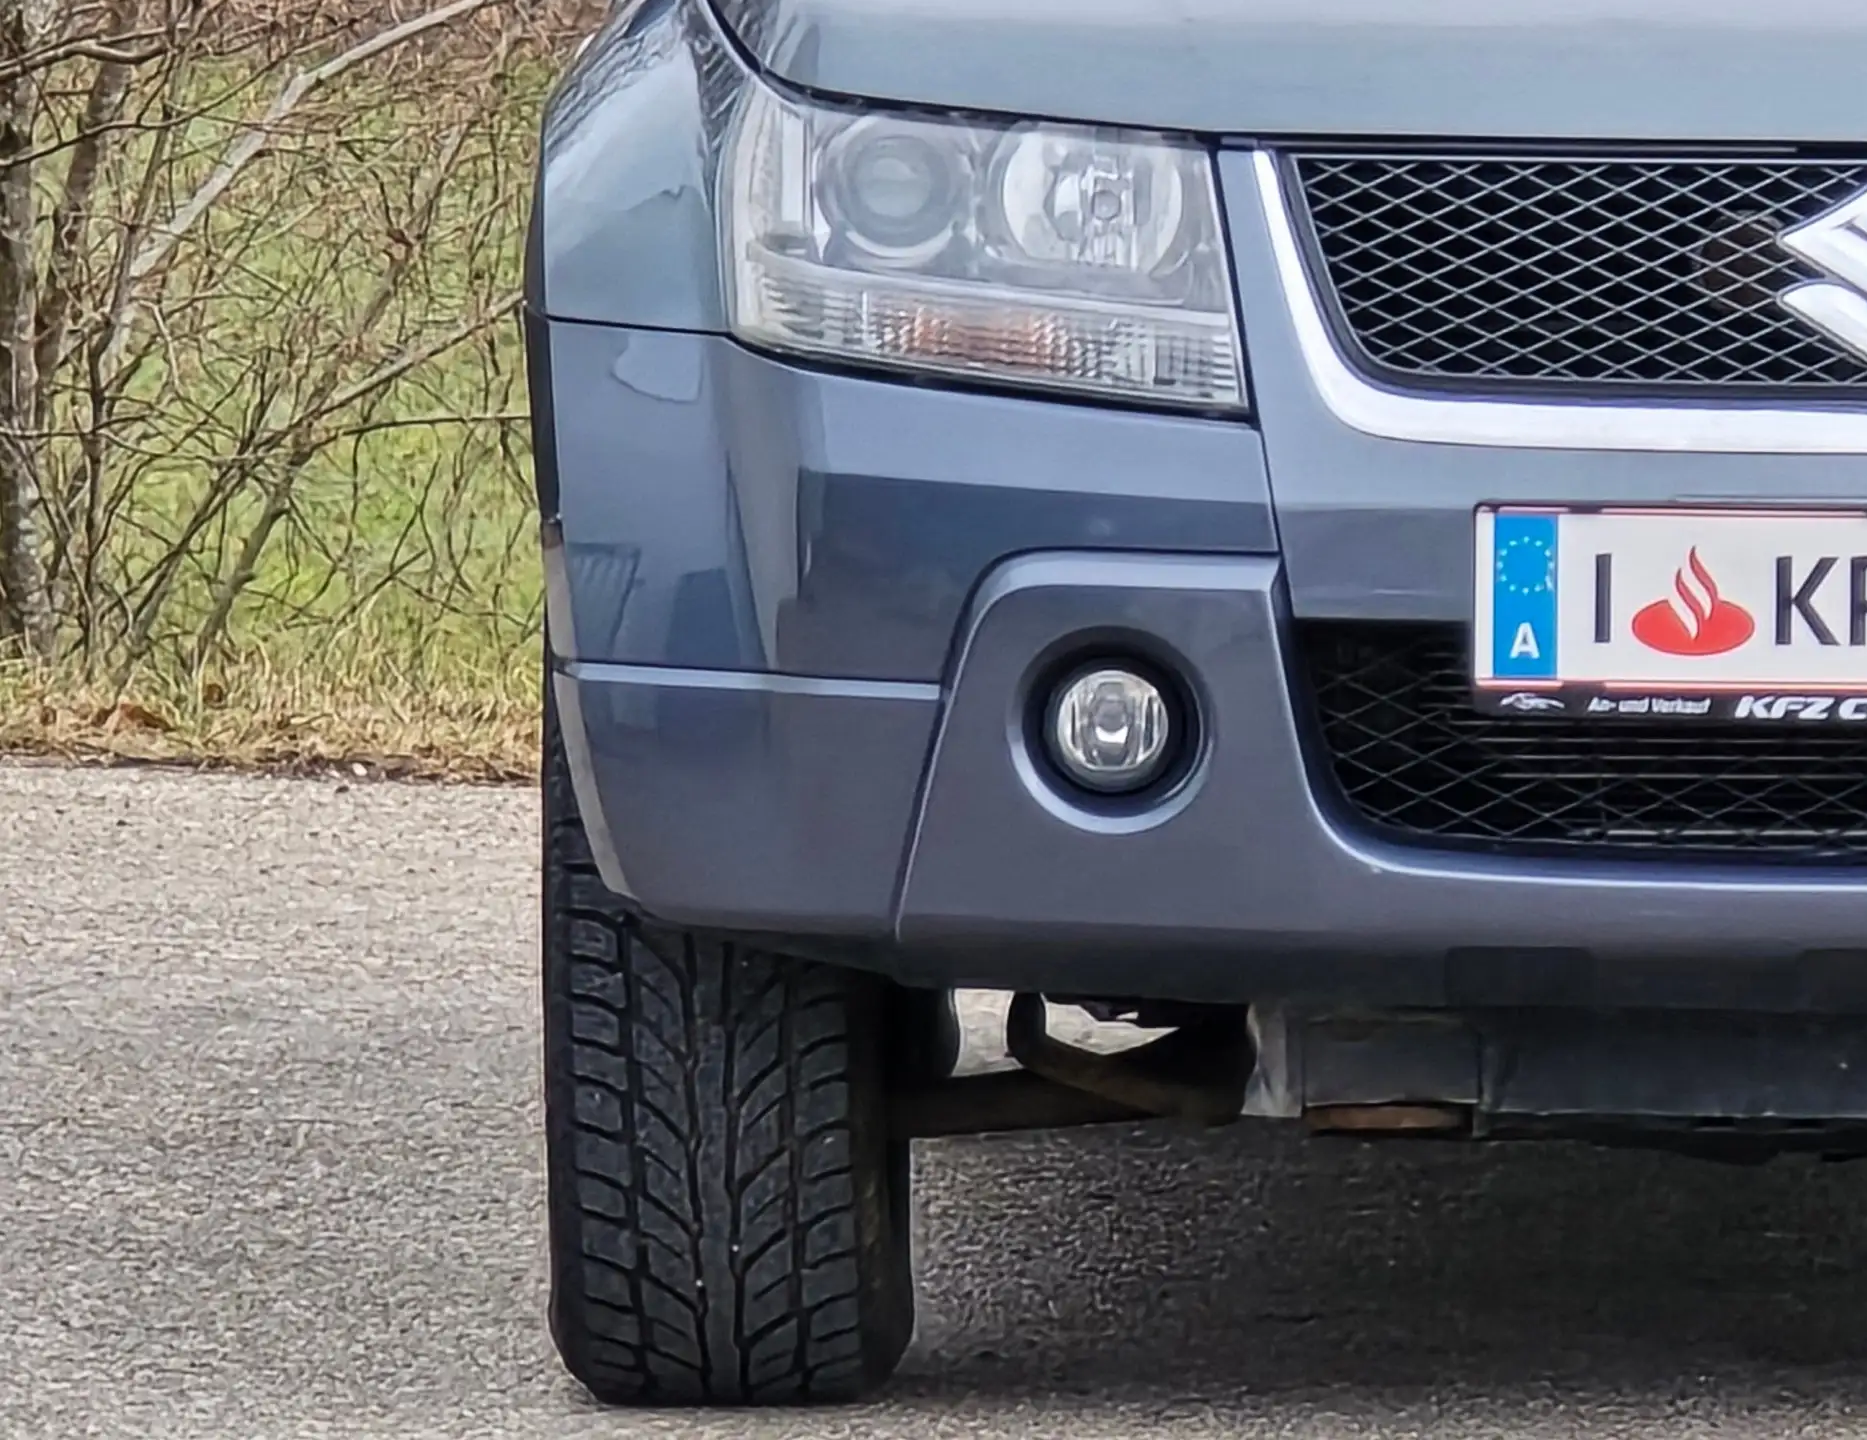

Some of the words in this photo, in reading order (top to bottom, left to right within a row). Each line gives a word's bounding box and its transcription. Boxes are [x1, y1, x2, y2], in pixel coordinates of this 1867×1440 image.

[1594, 553, 1612, 643] I
[1509, 622, 1540, 659] A
[1733, 695, 1837, 720] KFZ
